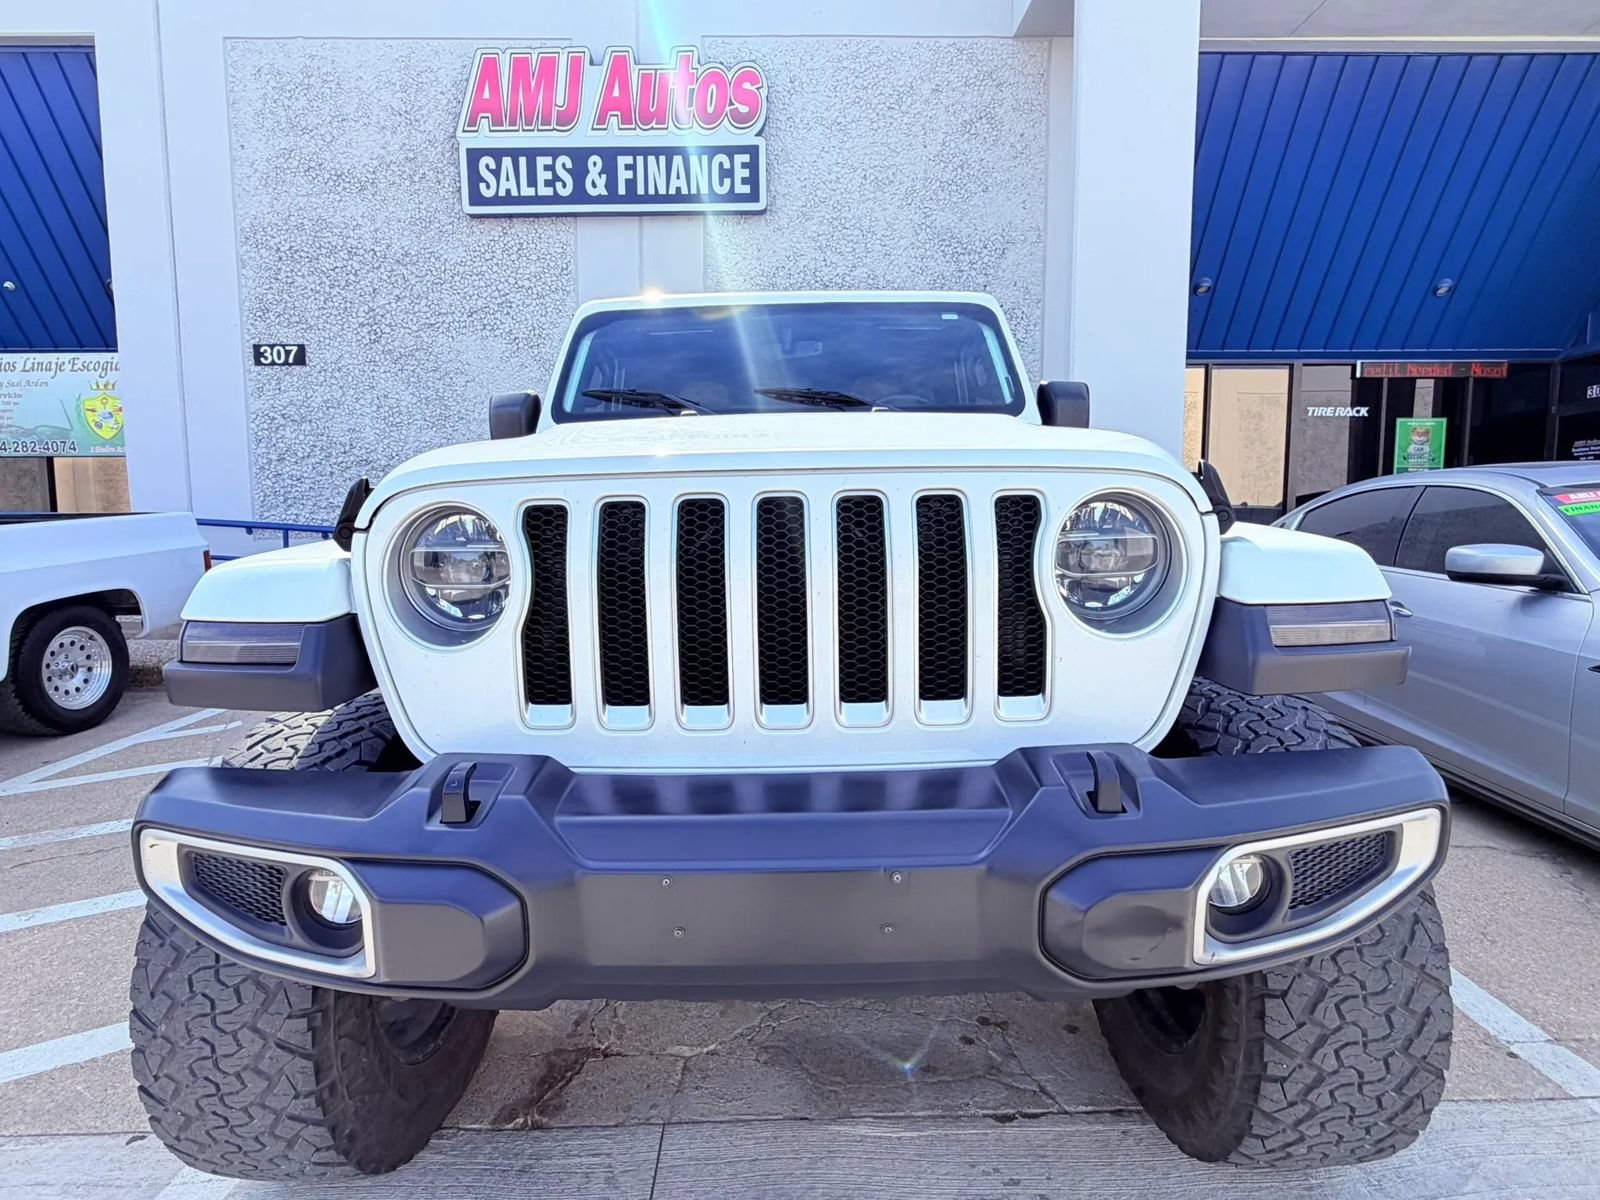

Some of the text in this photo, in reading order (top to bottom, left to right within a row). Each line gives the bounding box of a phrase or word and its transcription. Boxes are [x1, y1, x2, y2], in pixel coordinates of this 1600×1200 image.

[463, 50, 764, 132] AMJ Autos
[478, 153, 751, 197] SALES & FINANCE
[260, 345, 298, 364] 307
[20, 357, 66, 379] Linaje
[1565, 504, 1600, 513] FINAN
